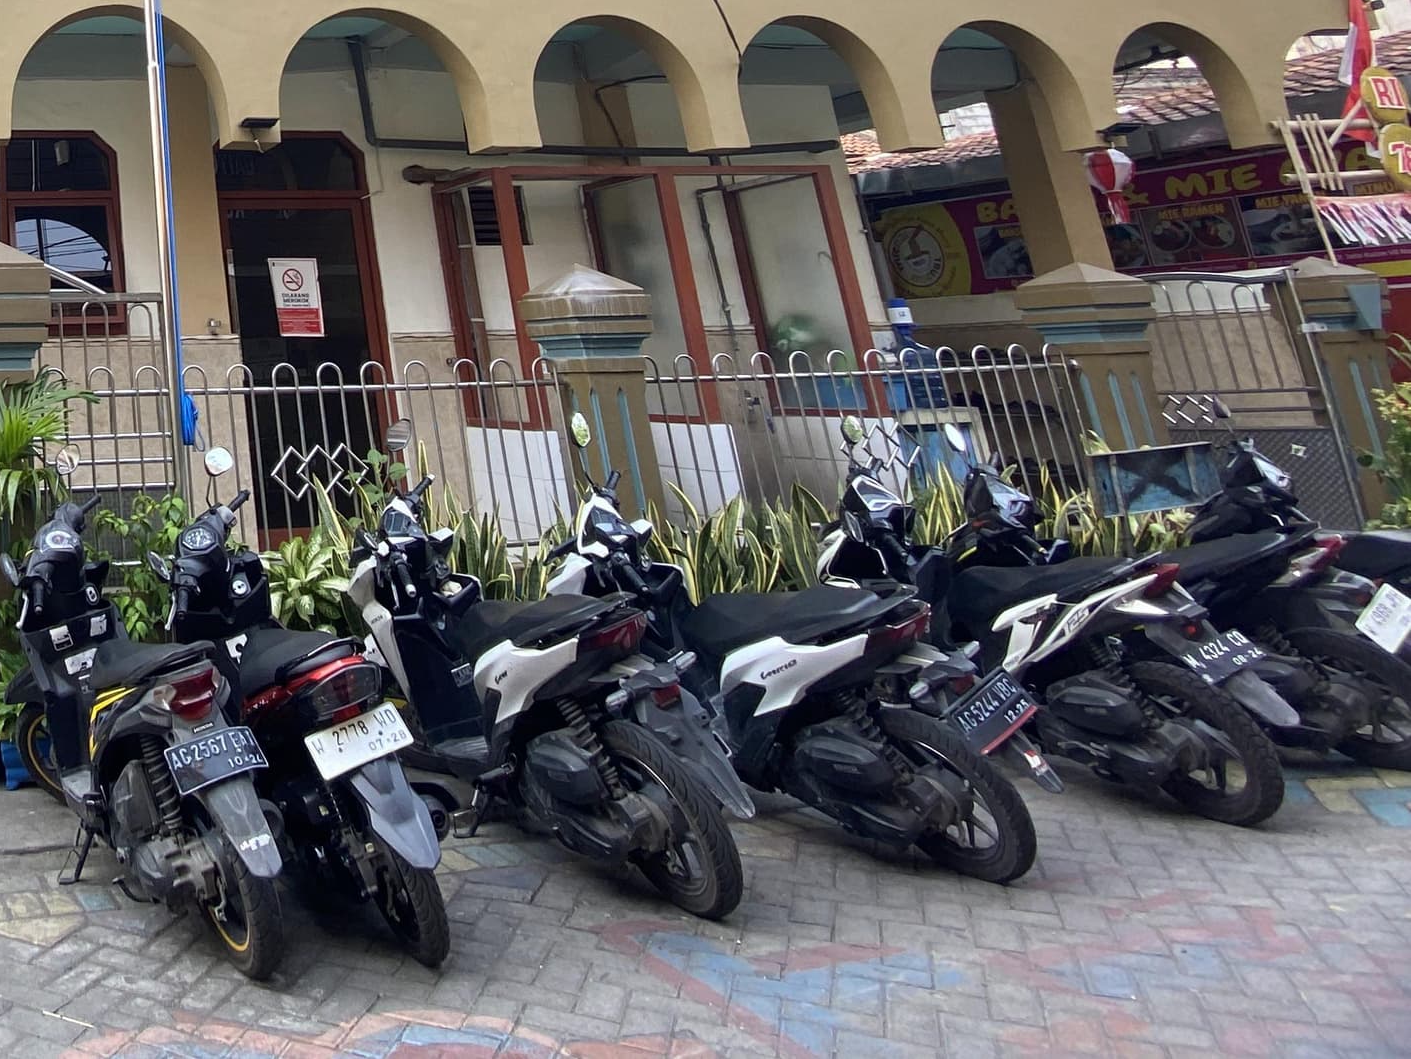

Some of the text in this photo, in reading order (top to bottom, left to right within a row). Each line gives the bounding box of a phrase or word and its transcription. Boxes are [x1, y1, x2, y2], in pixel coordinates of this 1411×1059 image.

[1369, 76, 1407, 109] RI
[1164, 163, 1261, 200] MIE
[1198, 639, 1230, 660] 4324
[971, 693, 999, 721] 5244
[992, 678, 1017, 700] VBC
[191, 735, 227, 761] 2567
[311, 737, 324, 755] W
[332, 720, 369, 746] 2778
